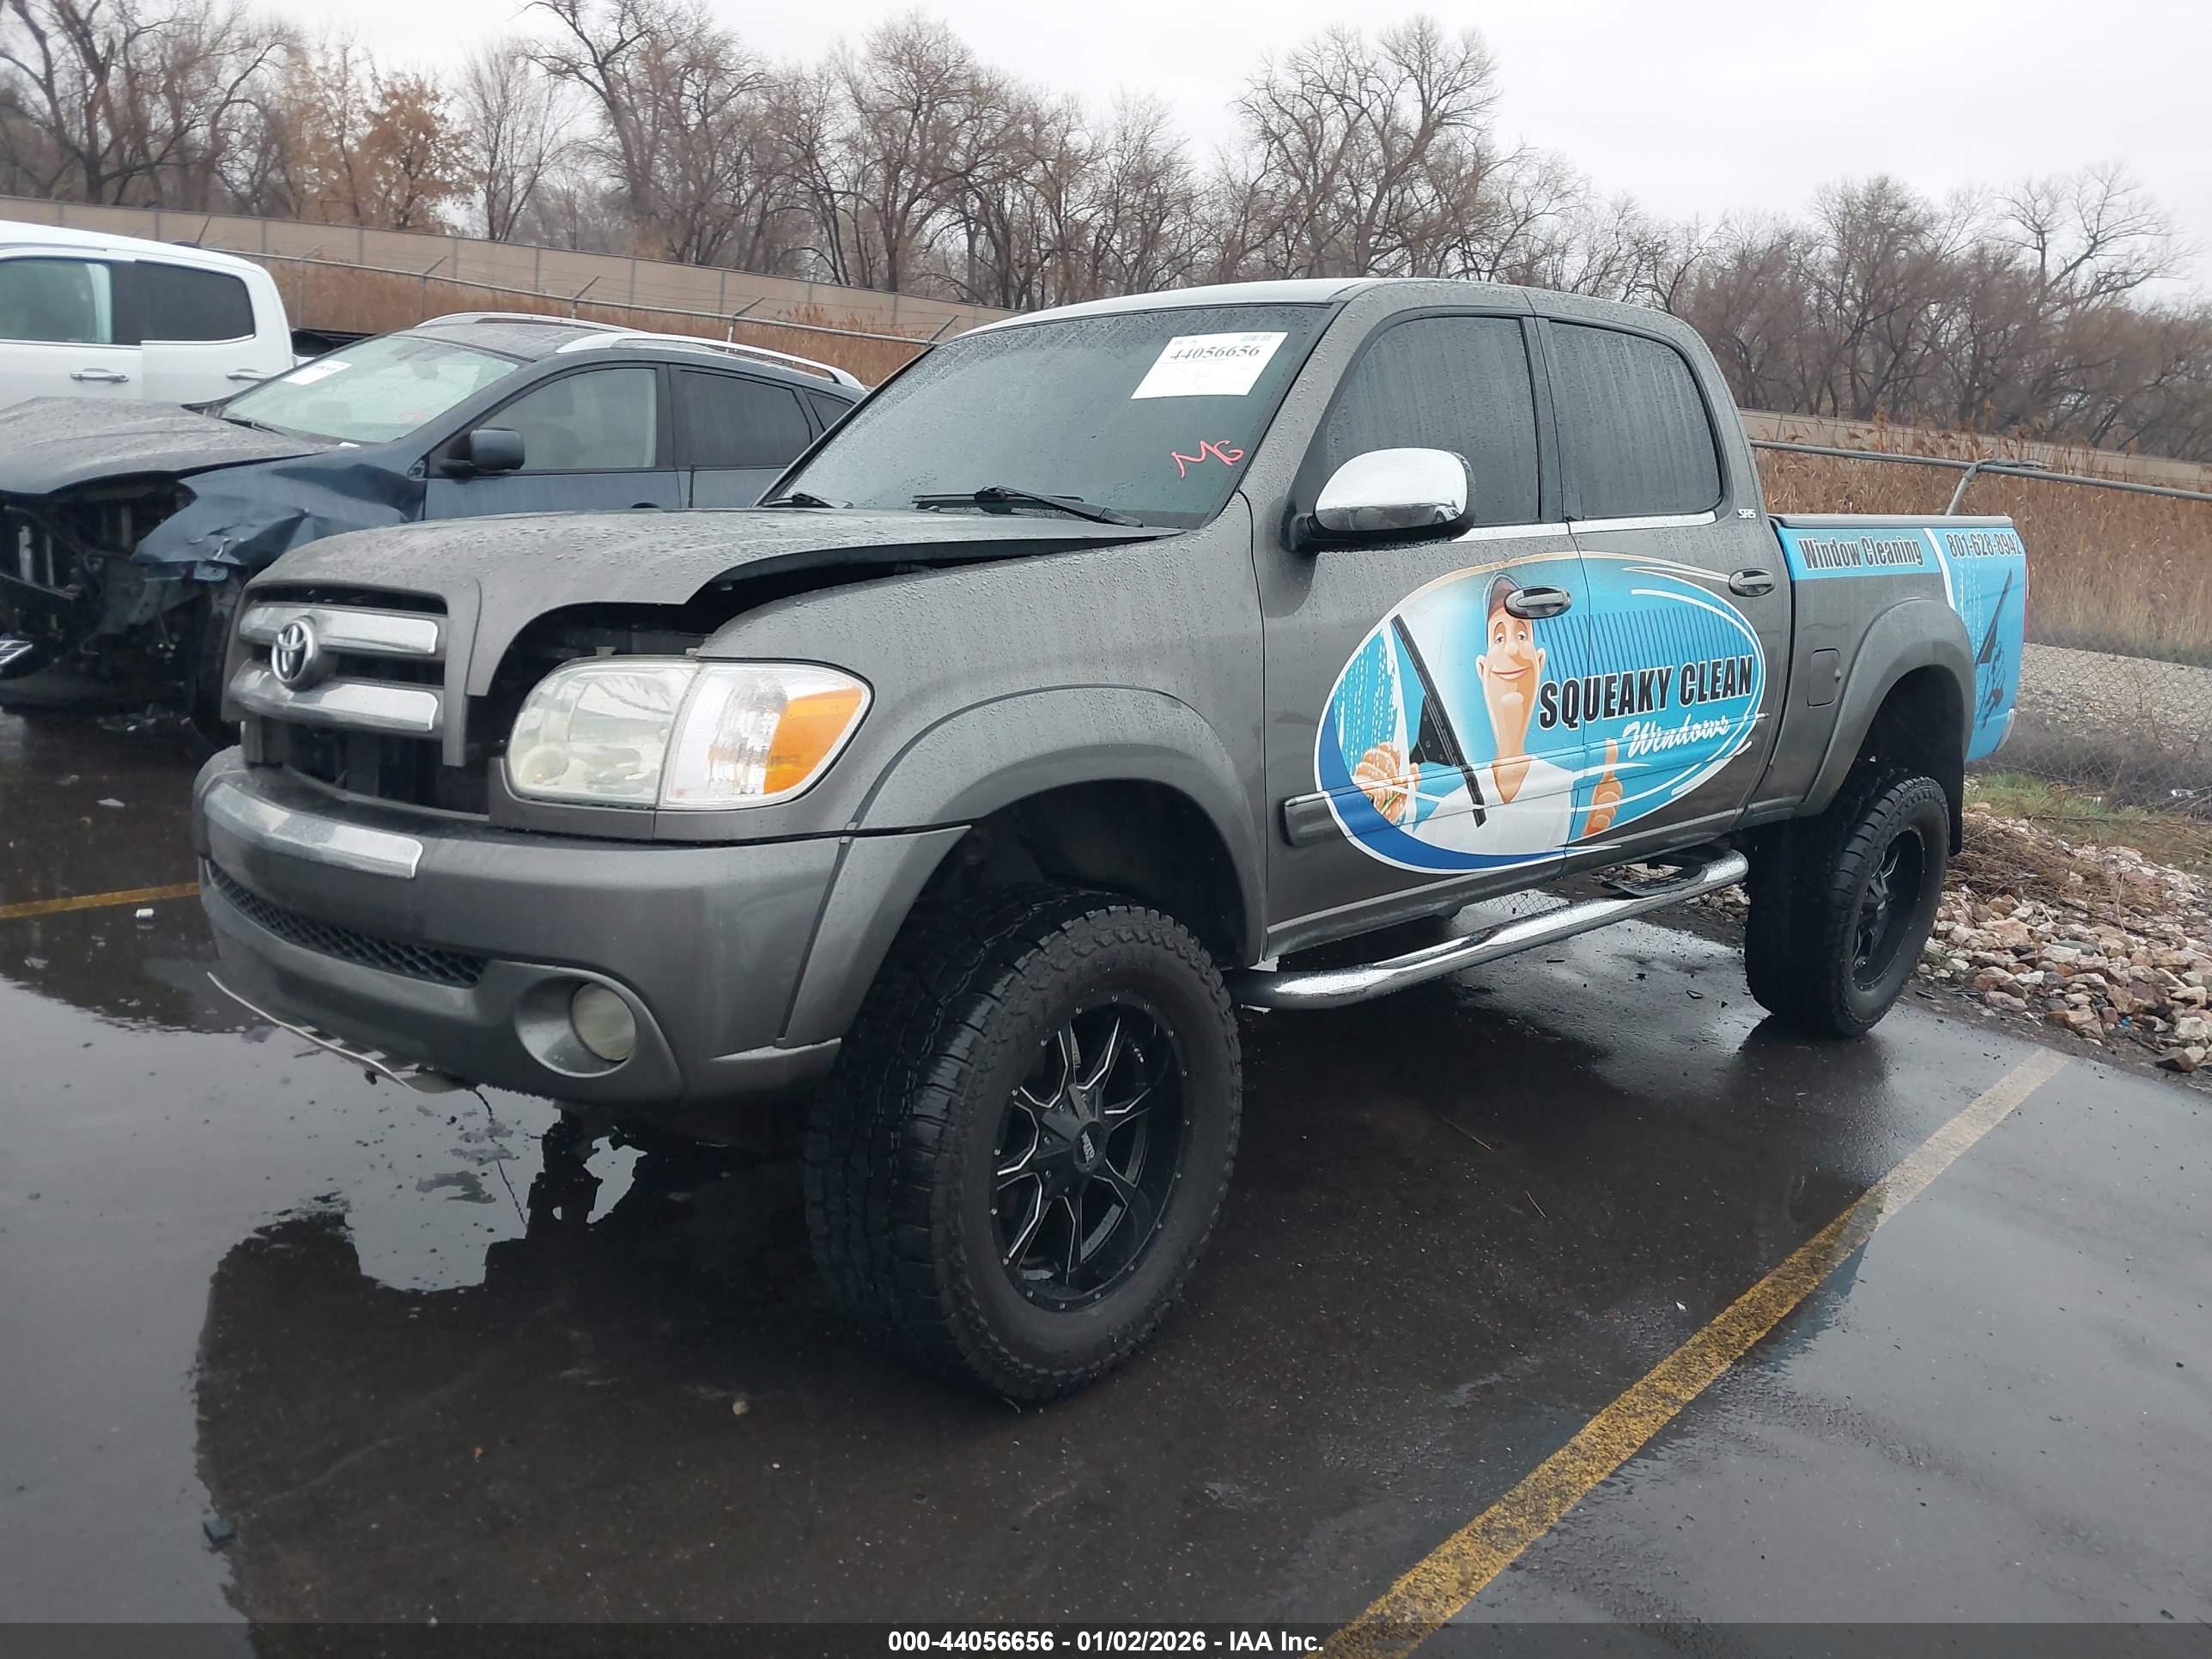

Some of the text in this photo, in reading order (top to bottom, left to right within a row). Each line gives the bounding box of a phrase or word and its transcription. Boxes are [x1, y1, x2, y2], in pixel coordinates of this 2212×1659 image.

[1170, 344, 1261, 361] 44056656
[1798, 536, 1923, 570] Window Cleaning
[1945, 532, 2022, 557] 801-628-8942
[1539, 655, 1753, 730] SQUEAKY CLEAN
[1622, 714, 1729, 758] Windows
